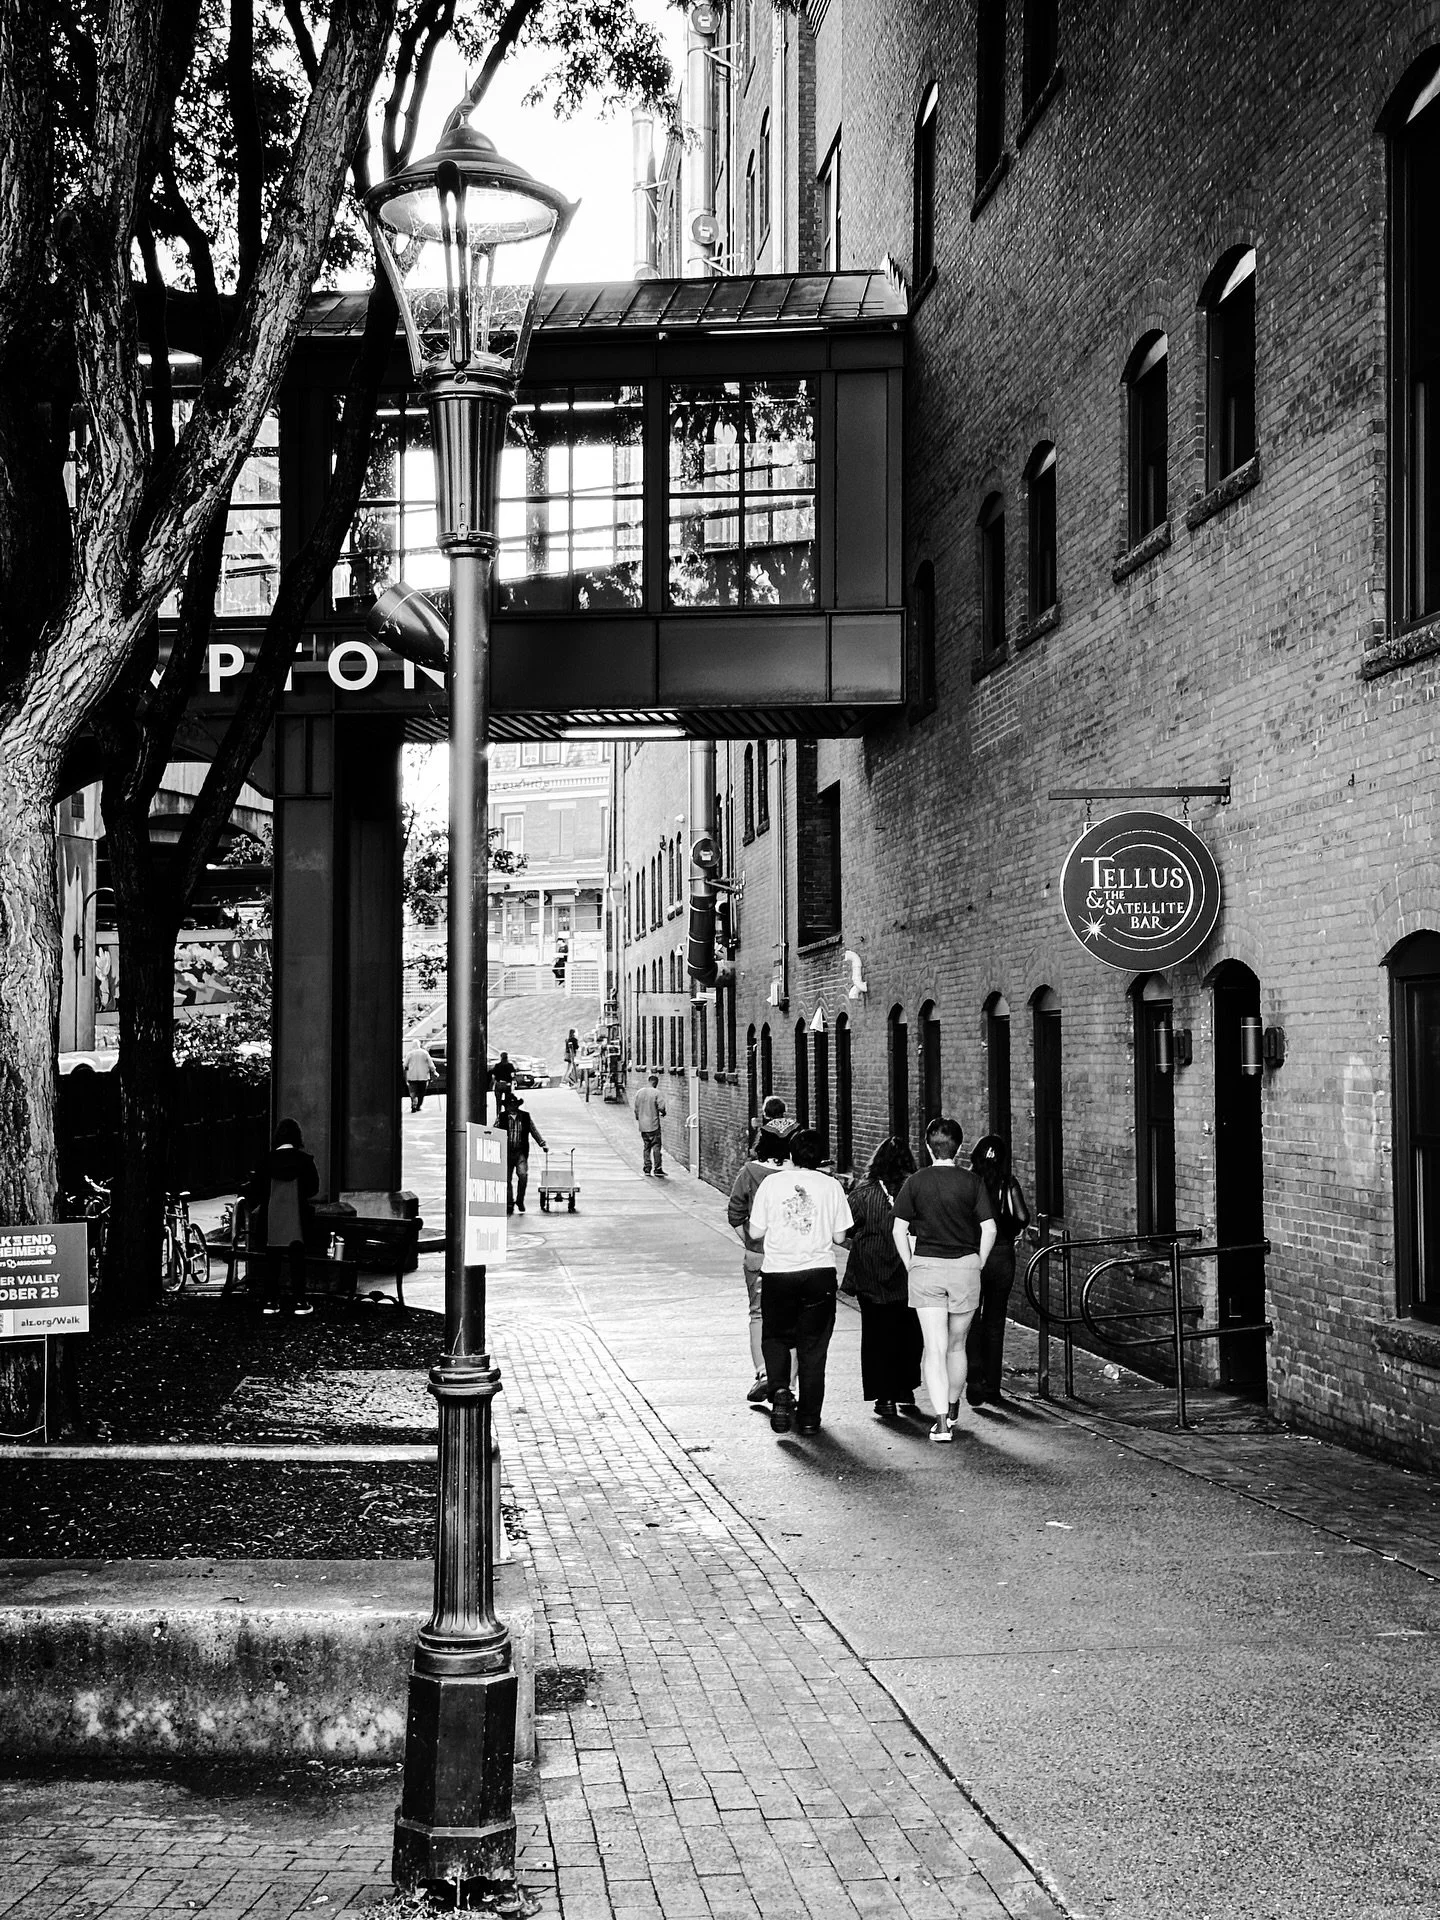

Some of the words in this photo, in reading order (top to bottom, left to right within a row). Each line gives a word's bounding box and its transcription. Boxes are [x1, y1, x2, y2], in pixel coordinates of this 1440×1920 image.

[1080, 857, 1184, 889] TELLUS
[1086, 890, 1105, 909] &
[1103, 891, 1126, 900] THE
[1105, 900, 1185, 916] SATELLITE
[1130, 916, 1170, 931] BAR
[17, 1273, 61, 1285] VALLEY
[40, 1286, 60, 1299] 25
[21, 1316, 80, 1328] alz.org/Walk
